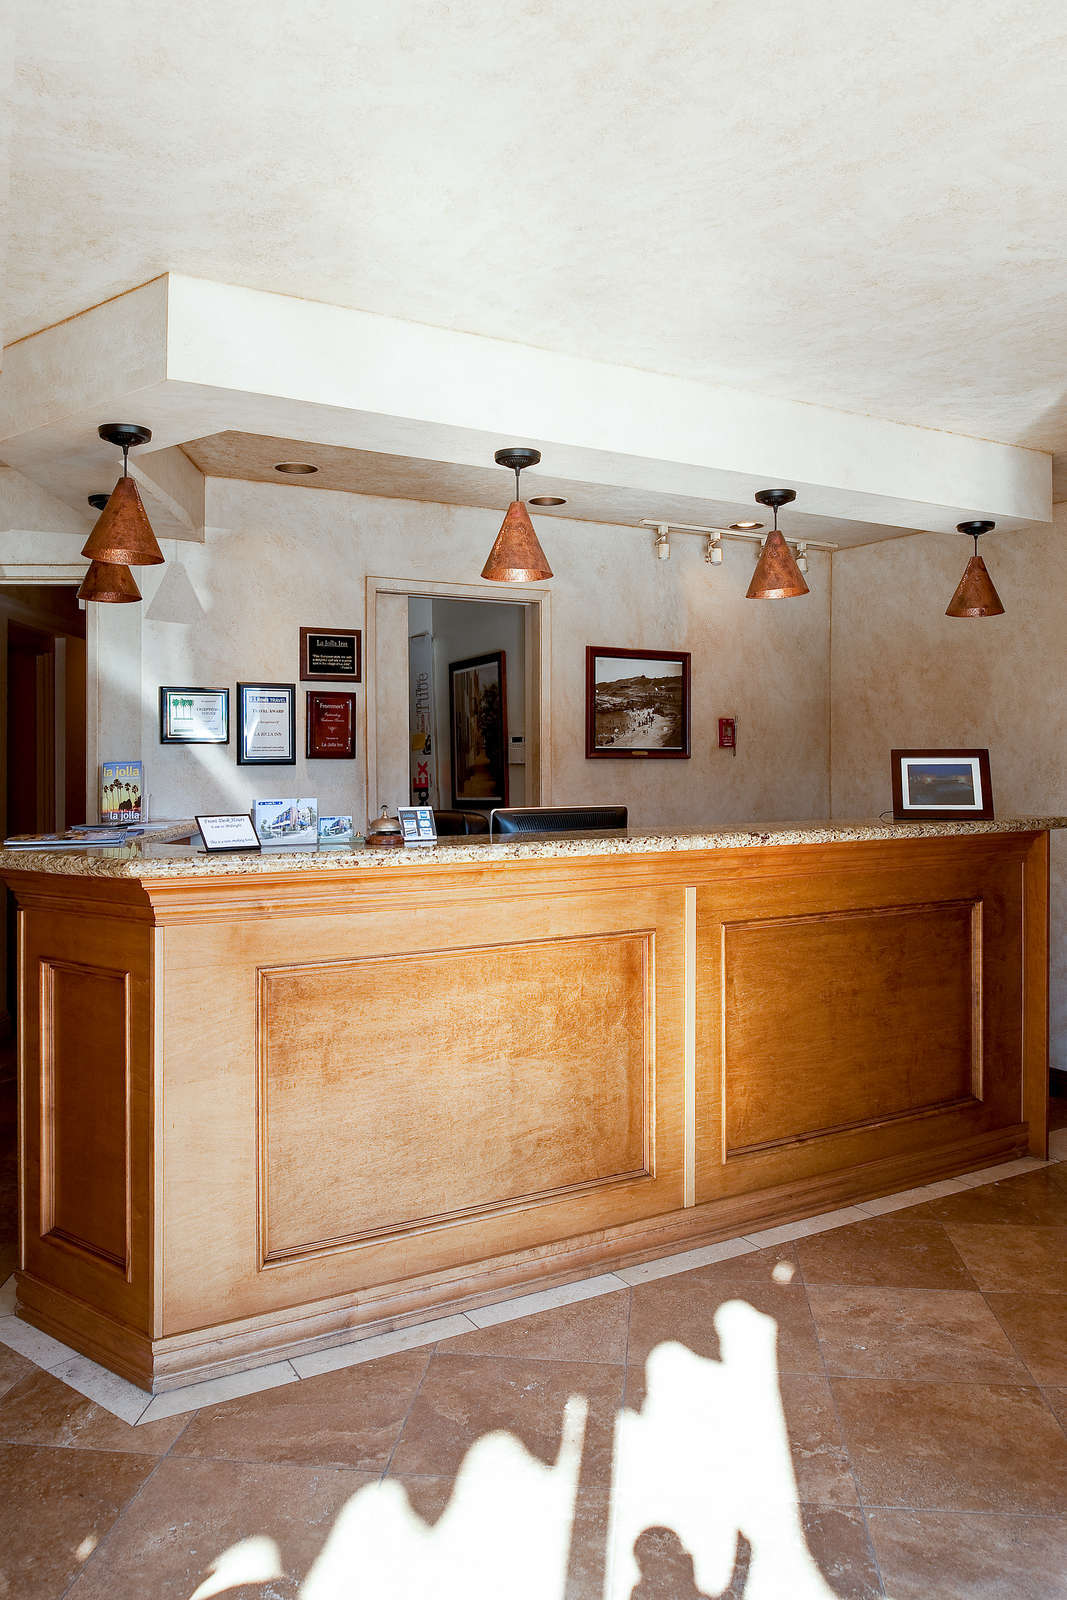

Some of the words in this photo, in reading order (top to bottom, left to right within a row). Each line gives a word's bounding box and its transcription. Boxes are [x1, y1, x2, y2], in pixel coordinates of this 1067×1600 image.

[104, 767, 112, 776] la
[115, 765, 139, 779] jolla
[110, 811, 118, 820] la
[120, 811, 140, 821] jolla
